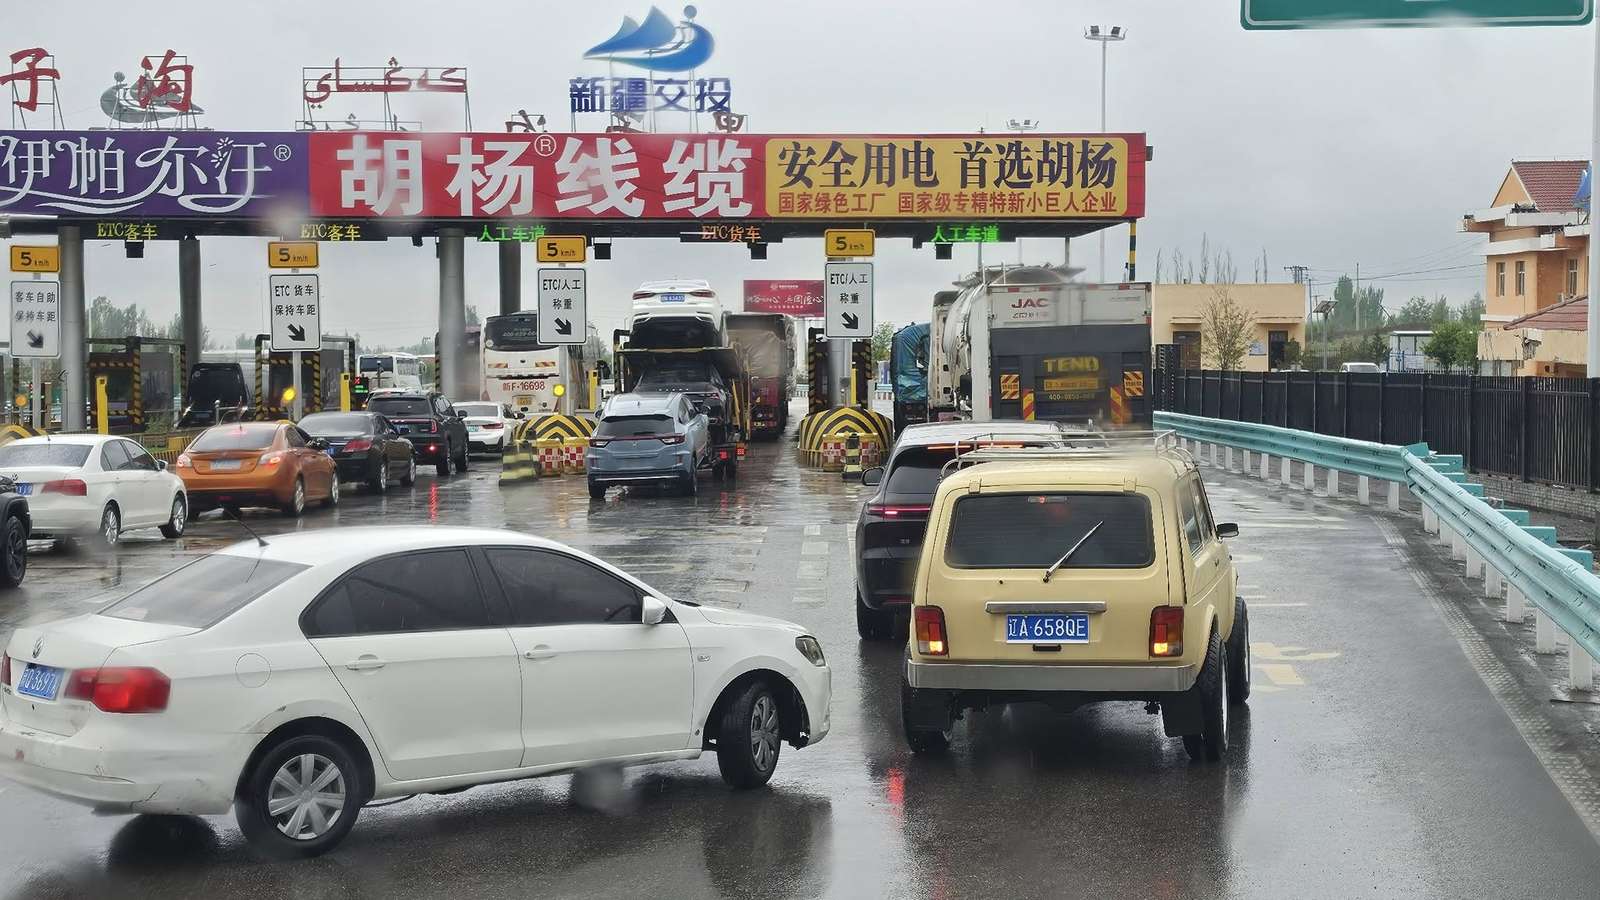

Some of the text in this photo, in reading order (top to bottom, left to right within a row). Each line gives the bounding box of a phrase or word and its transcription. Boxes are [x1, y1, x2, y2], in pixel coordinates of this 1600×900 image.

[570, 76, 731, 113] 新疆交投
[778, 140, 1119, 190] 安全用电 首选胡杨
[778, 191, 1119, 214] 国家绿色工厂 国家级专精特新小巨人企业
[96, 222, 158, 240] ETC客车
[300, 223, 361, 241] ETC客车
[701, 225, 762, 243] ETC货车
[931, 225, 1000, 242] 人工车道
[547, 243, 559, 257] 5
[836, 236, 848, 251] 5
[20, 251, 33, 266] 5
[279, 247, 291, 262] 5
[543, 278, 581, 291] ETC/人工
[830, 273, 868, 285] ETC/人工
[15, 291, 56, 304] 客车自助
[274, 284, 314, 297] ETC 货车
[552, 298, 573, 311] 称重
[840, 292, 860, 305] 称重
[1011, 297, 1049, 309] JAC
[15, 310, 57, 323] 保持车距
[274, 304, 317, 317] 保持车距
